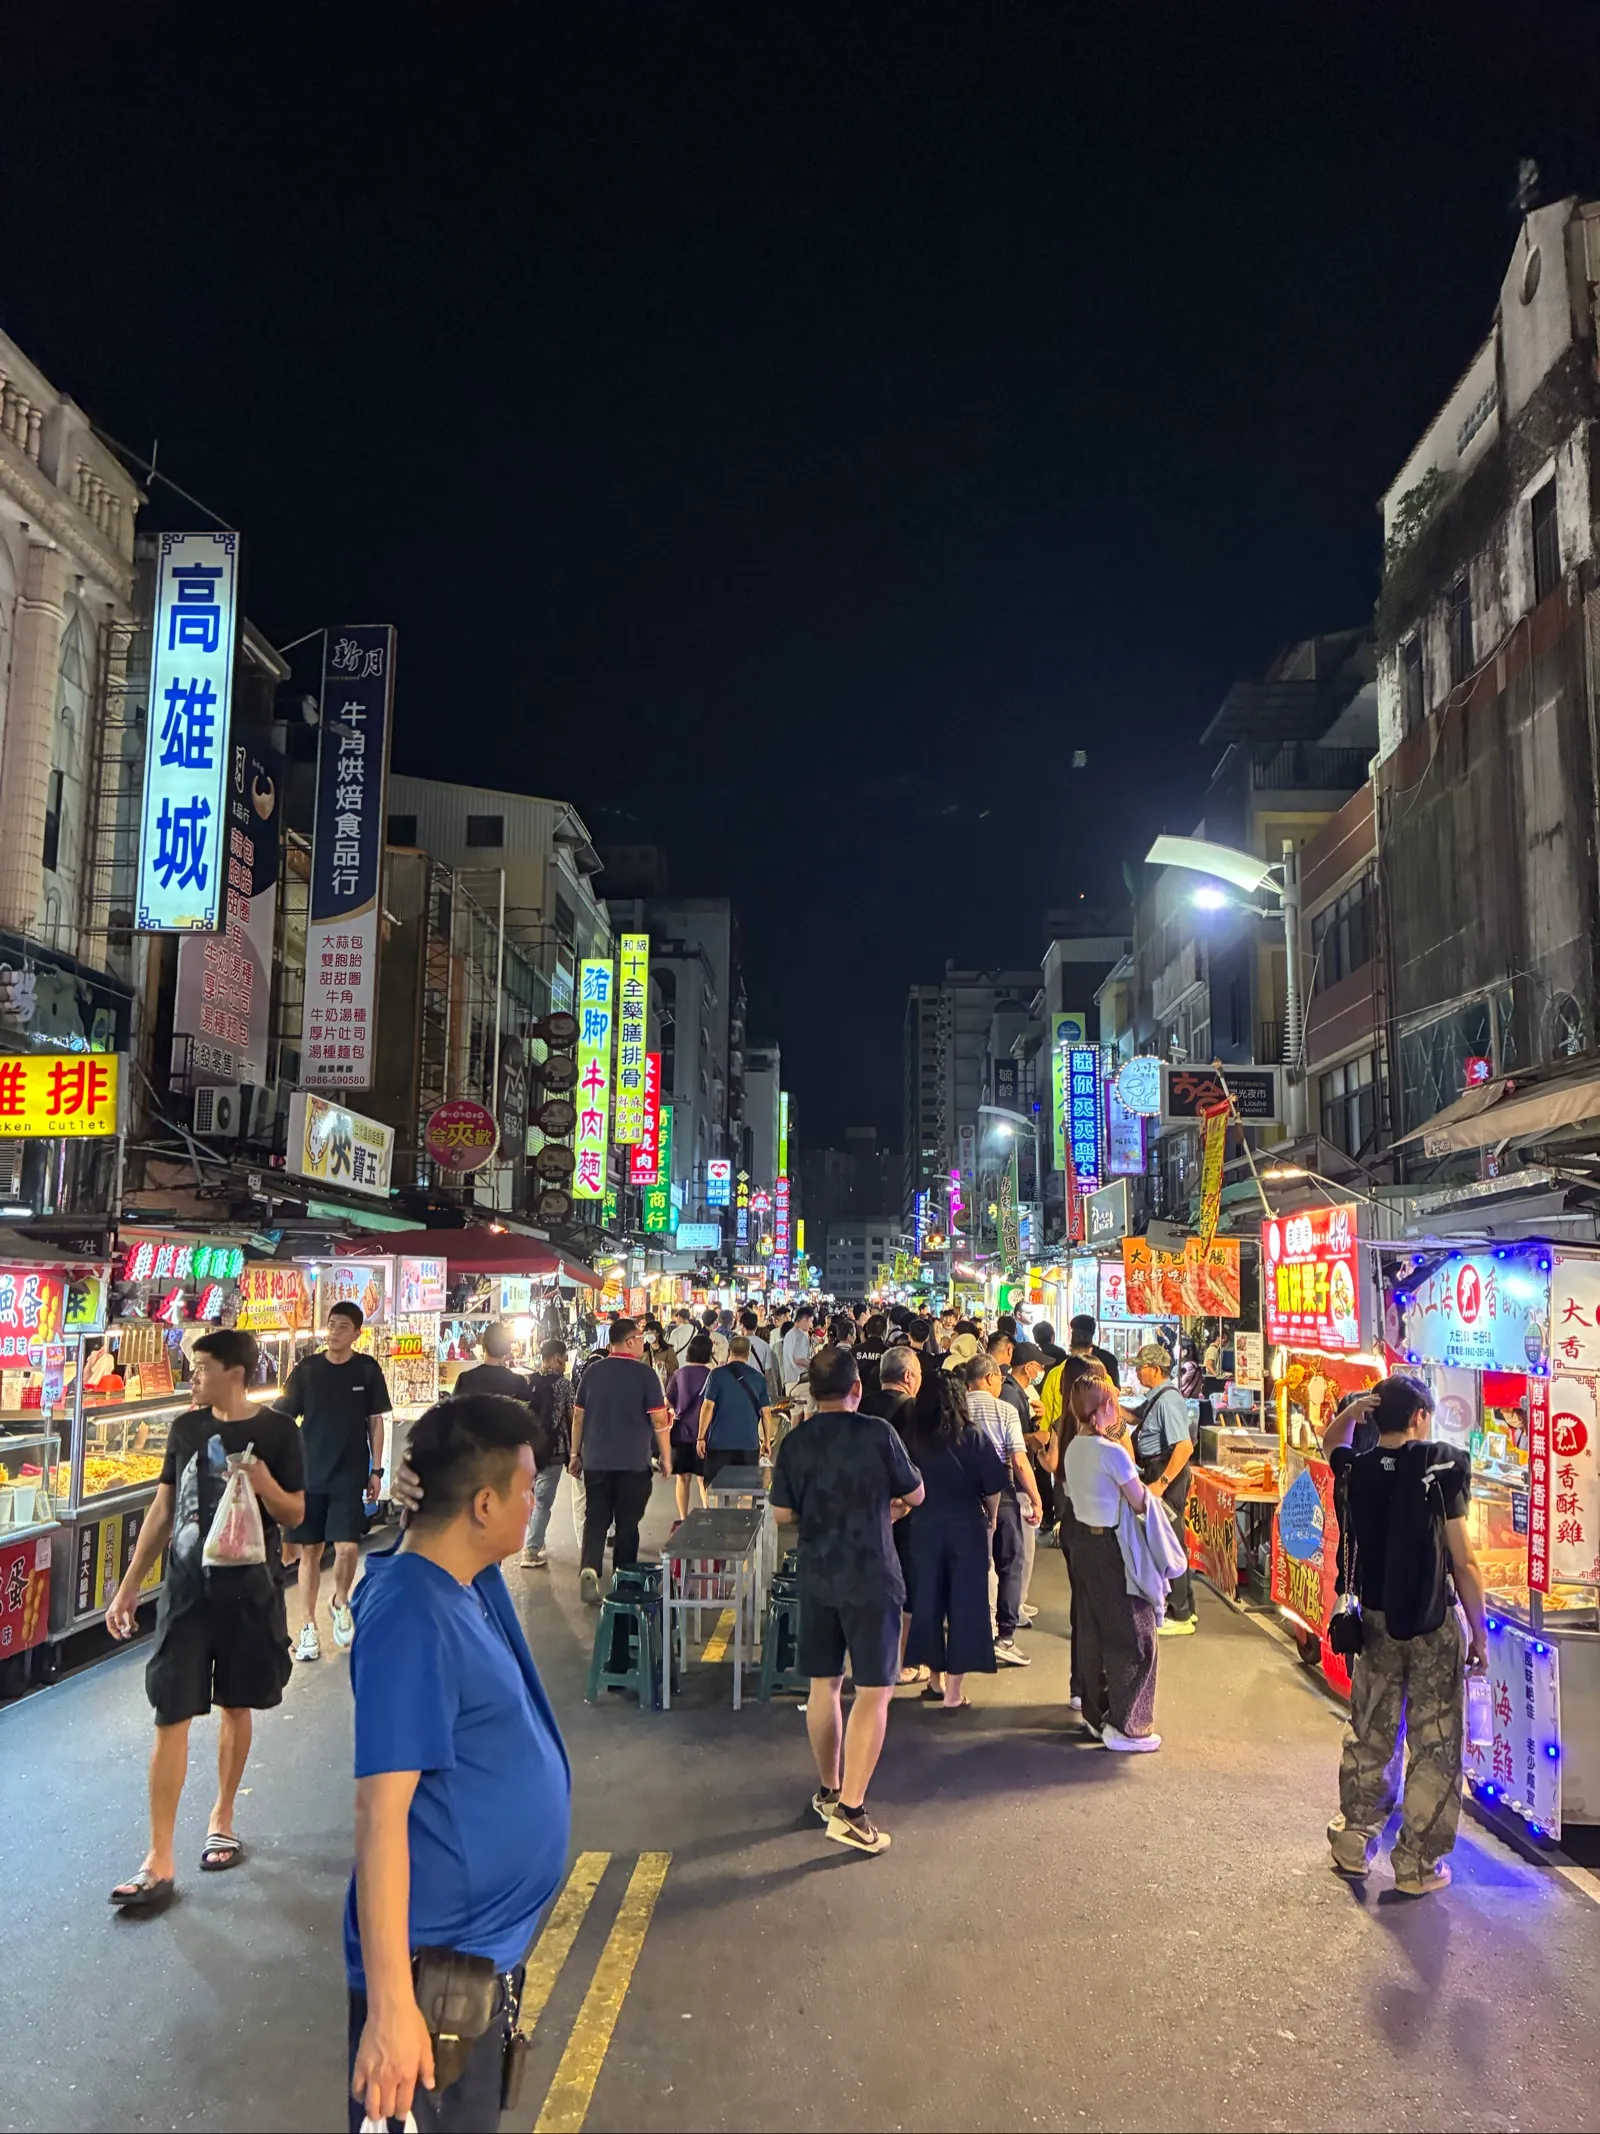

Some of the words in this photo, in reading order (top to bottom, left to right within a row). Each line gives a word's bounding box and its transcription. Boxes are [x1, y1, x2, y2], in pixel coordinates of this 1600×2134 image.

[153, 562, 223, 891] 高雄城
[332, 702, 367, 895] 牛角烘焙食品行
[321, 935, 363, 949] 大蒜包
[321, 953, 362, 968] 雙胞胎
[319, 972, 361, 986] 甜甜圈
[326, 990, 353, 1004] 牛角
[310, 1008, 367, 1022] 牛奶湯種
[620, 955, 645, 1088] 十全藥膳排骨
[309, 1026, 366, 1041] 厚片吐司
[308, 1045, 365, 1059] 湯種麵包
[305, 1076, 365, 1085] 0986-590580
[1073, 1052, 1095, 1162] 迷你夾夾樂
[48, 1120, 106, 1131] Cutlet
[630, 1096, 643, 1140] 麻油雞
[1131, 1250, 1226, 1266] 大腸包小腸
[1131, 1269, 1188, 1283] 超好吃!
[400, 1339, 421, 1354] 100
[1531, 1381, 1546, 1583] 厚切無骨香酥雞排
[1556, 1462, 1585, 1546] 香酥雞
